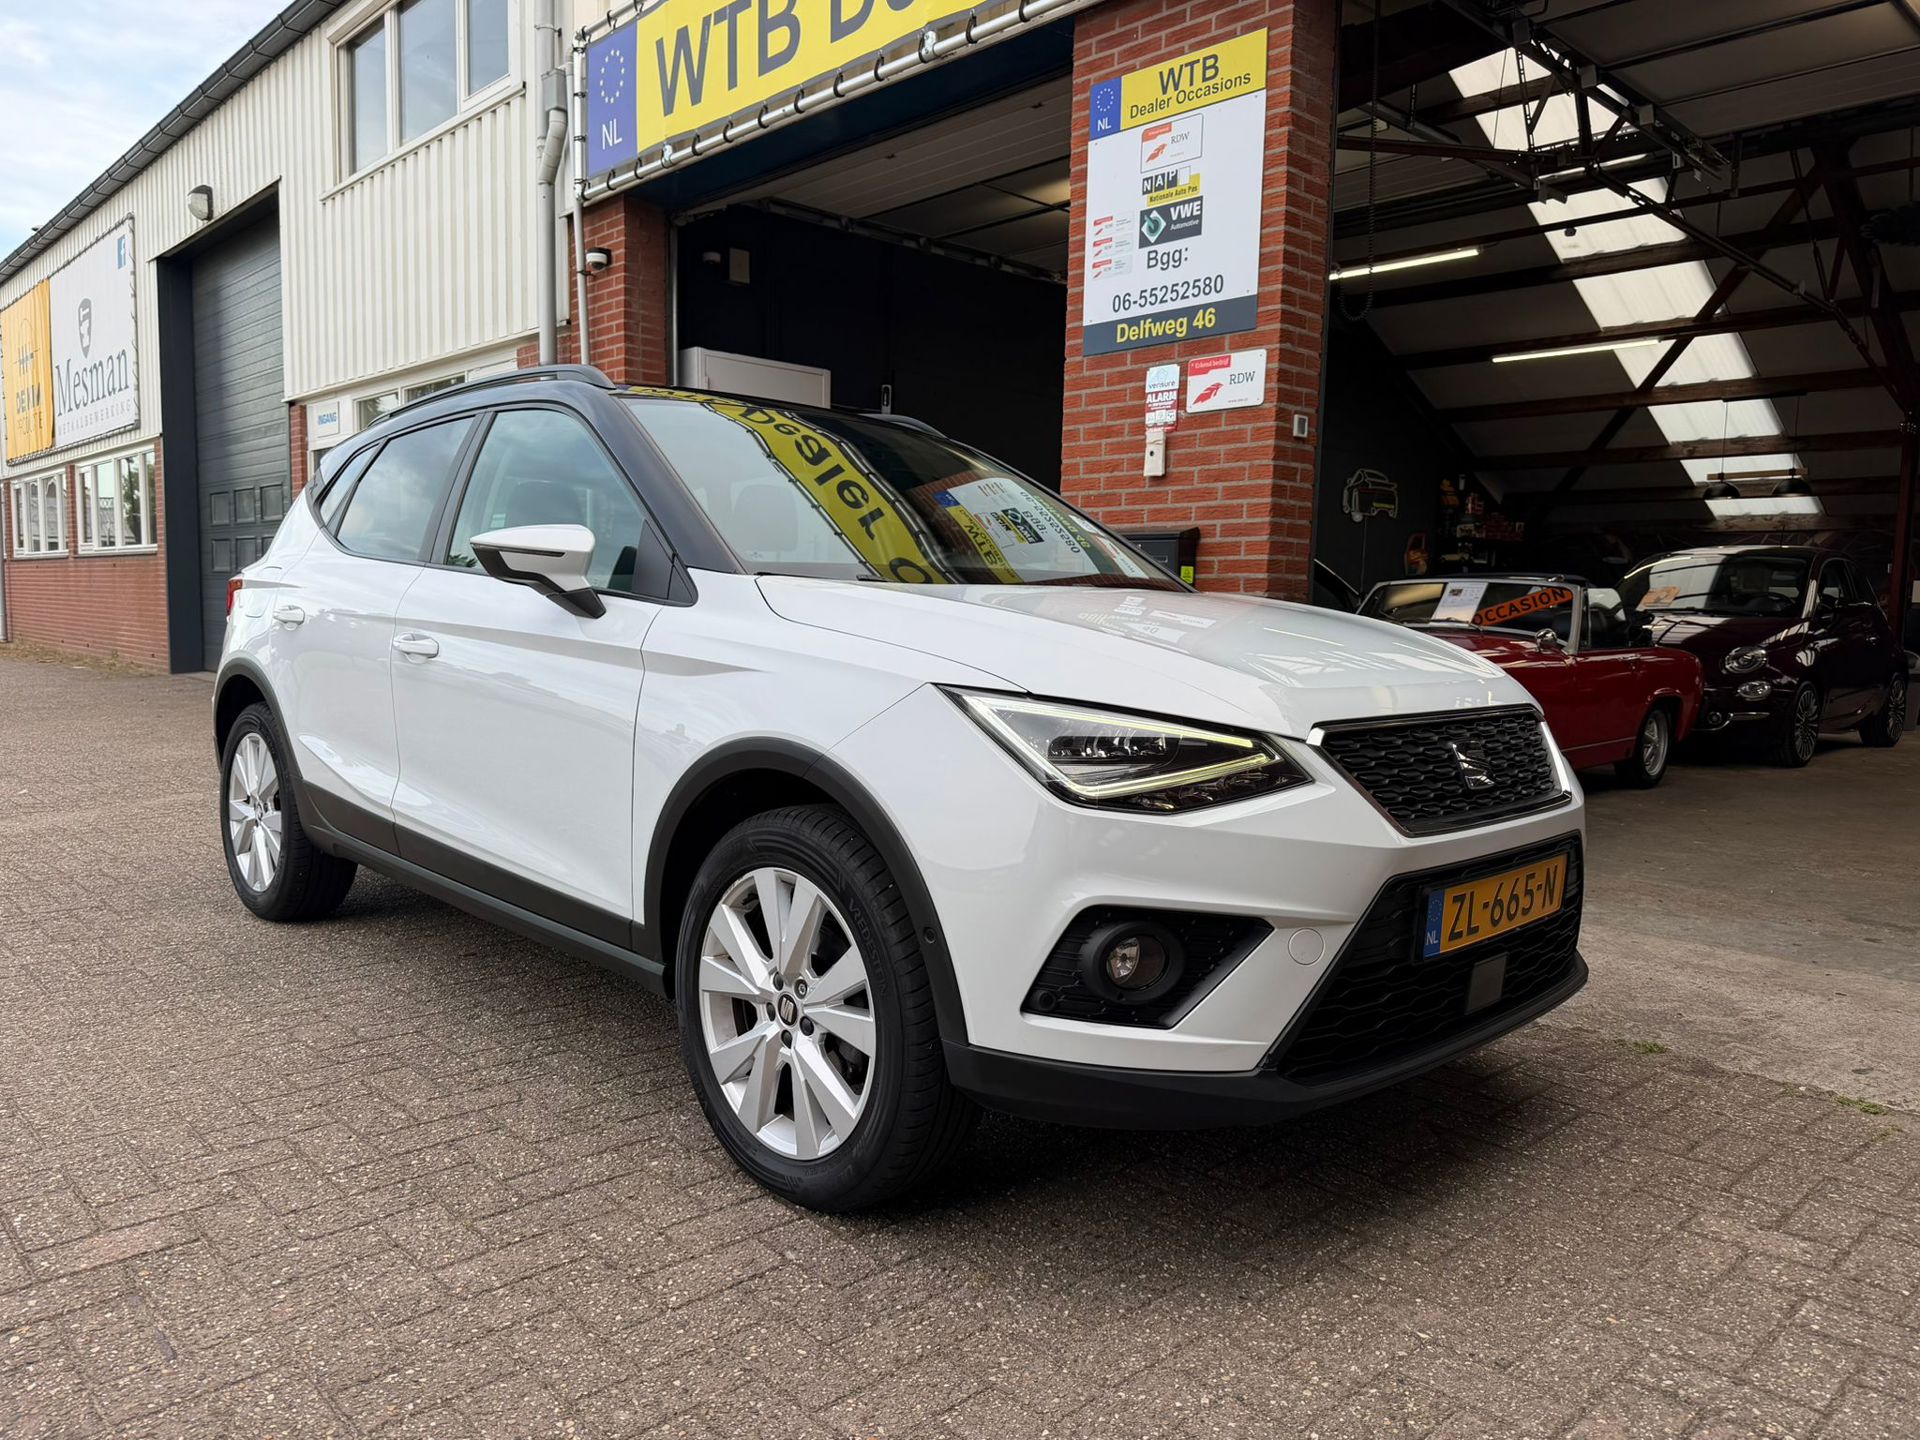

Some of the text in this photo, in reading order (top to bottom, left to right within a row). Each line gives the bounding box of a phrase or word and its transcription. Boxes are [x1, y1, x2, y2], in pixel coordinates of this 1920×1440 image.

[655, 0, 801, 117] WTB
[1158, 53, 1220, 96] WTB
[1129, 72, 1251, 119] Dealer Occasions
[602, 119, 622, 150] NL
[1097, 119, 1112, 132] NL
[1170, 131, 1191, 144] RDW
[1170, 200, 1202, 220] VWE
[1146, 245, 1189, 270] Bgg:
[1112, 274, 1224, 313] 06-55252580
[1116, 308, 1216, 343] Delfweg 46
[56, 348, 130, 417] Mesman
[1229, 371, 1256, 385] RDW
[1146, 390, 1177, 404] ALARM
[317, 411, 338, 425] INGANG
[1472, 587, 1566, 626] OCCASION
[1448, 865, 1558, 942] ZL-665-N
[1425, 930, 1439, 946] NL
